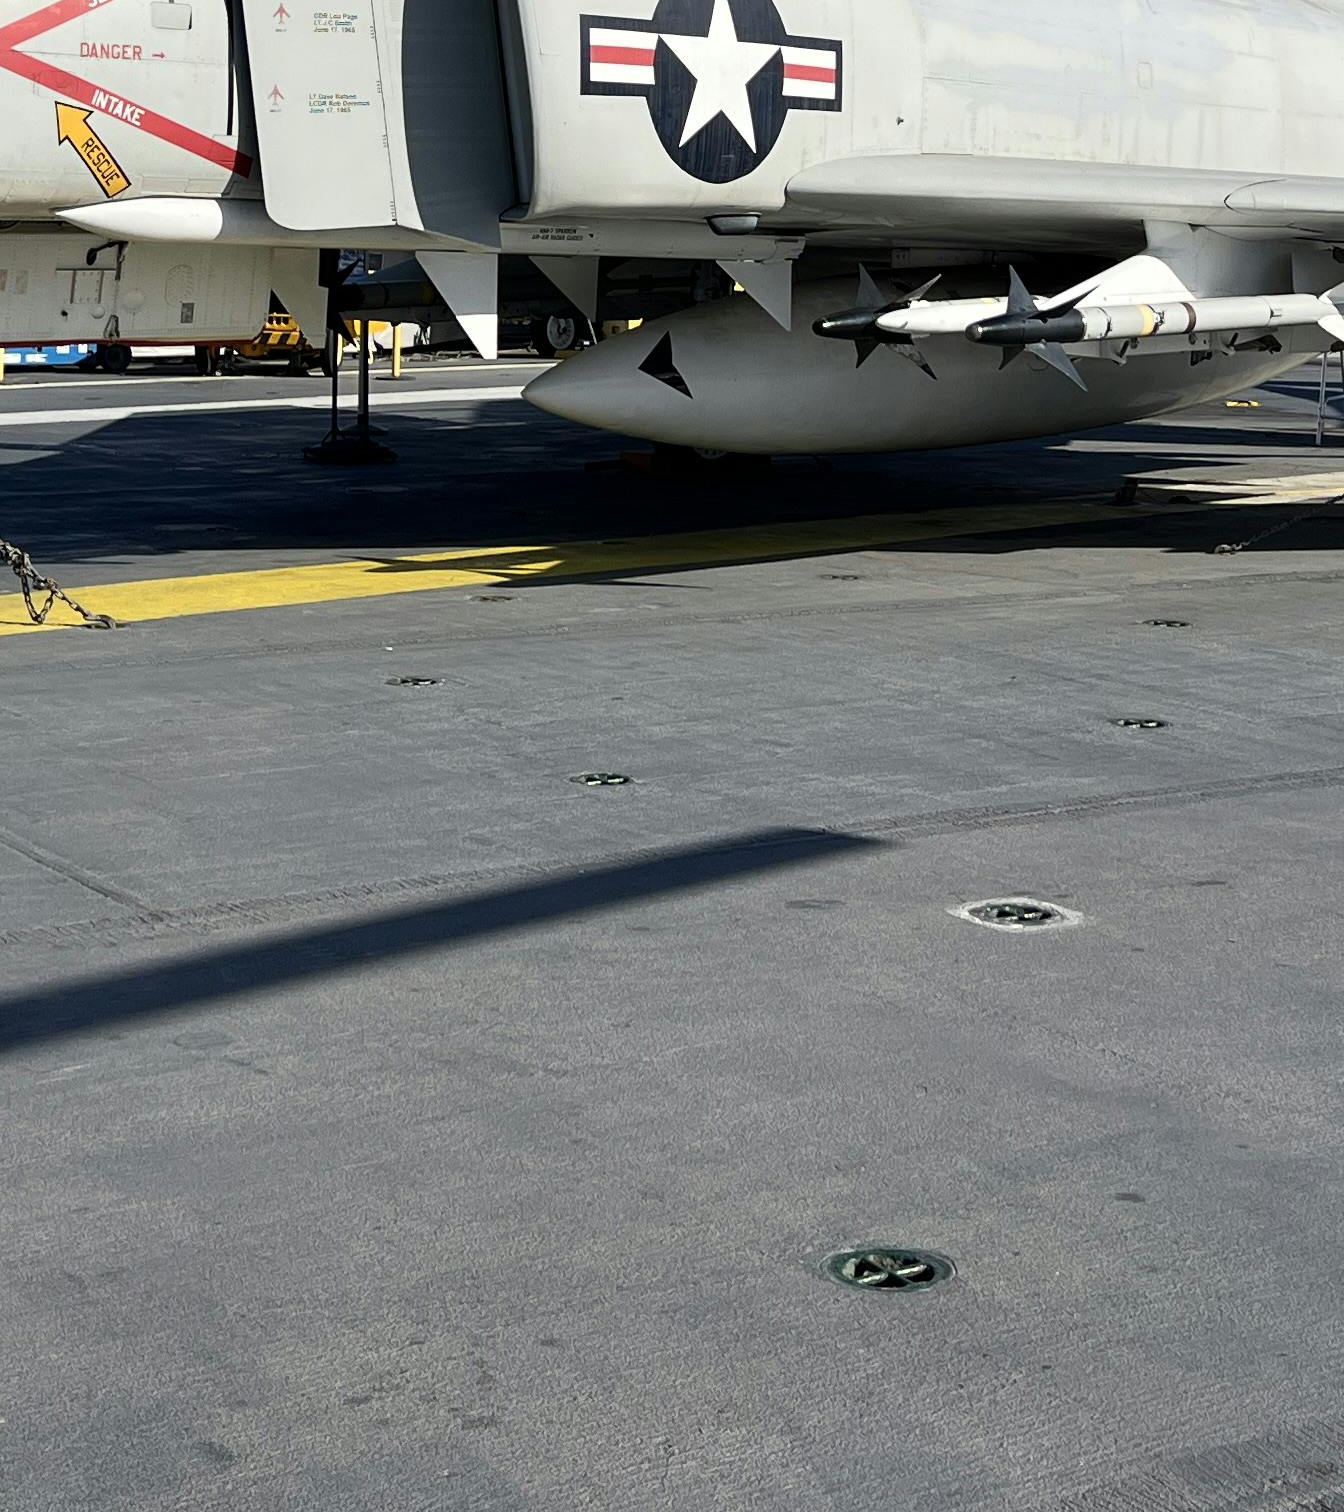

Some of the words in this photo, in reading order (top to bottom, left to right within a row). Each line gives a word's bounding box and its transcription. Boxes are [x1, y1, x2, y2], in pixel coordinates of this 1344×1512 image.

[80, 42, 142, 61] DANGER
[91, 89, 145, 127] INTAKE
[81, 137, 120, 187] RESCUE
